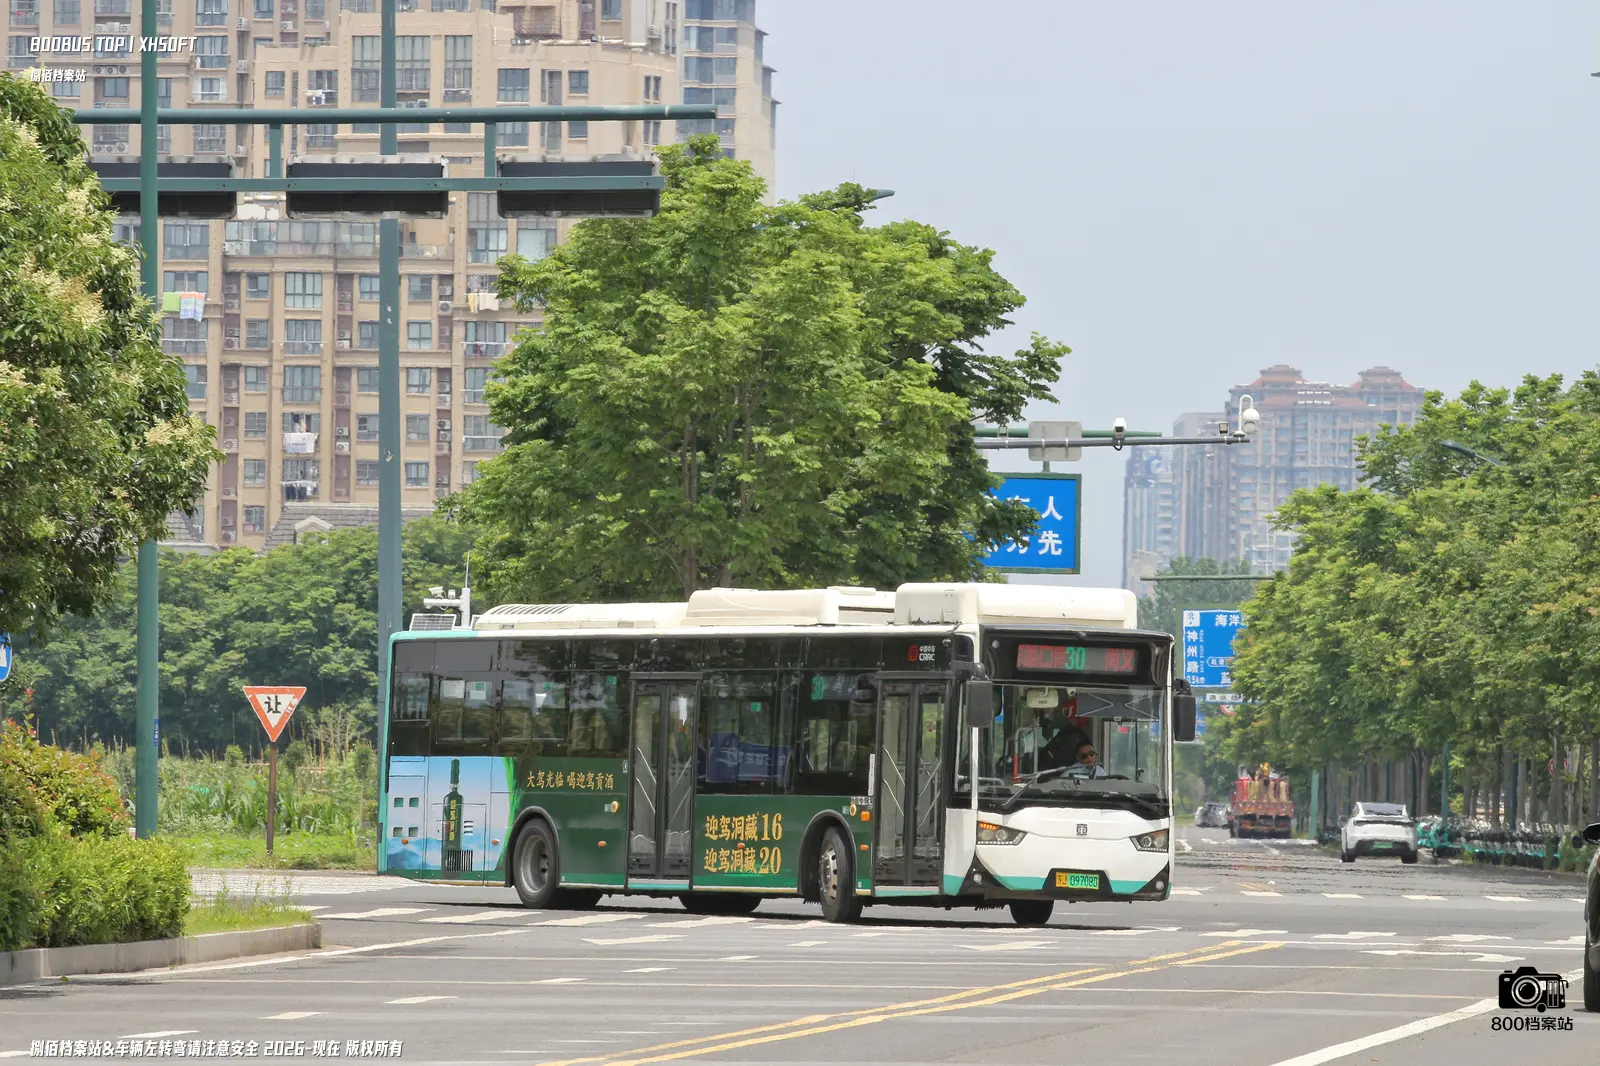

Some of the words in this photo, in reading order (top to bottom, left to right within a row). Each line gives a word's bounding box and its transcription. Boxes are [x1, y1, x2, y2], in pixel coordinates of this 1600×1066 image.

[1215, 614, 1249, 627] 海洋
[919, 653, 936, 661] CRRC
[1065, 646, 1087, 671] 30
[264, 695, 282, 714] 让
[526, 770, 564, 790] 大驾光临
[566, 771, 614, 791] 喝迎驾贡酒
